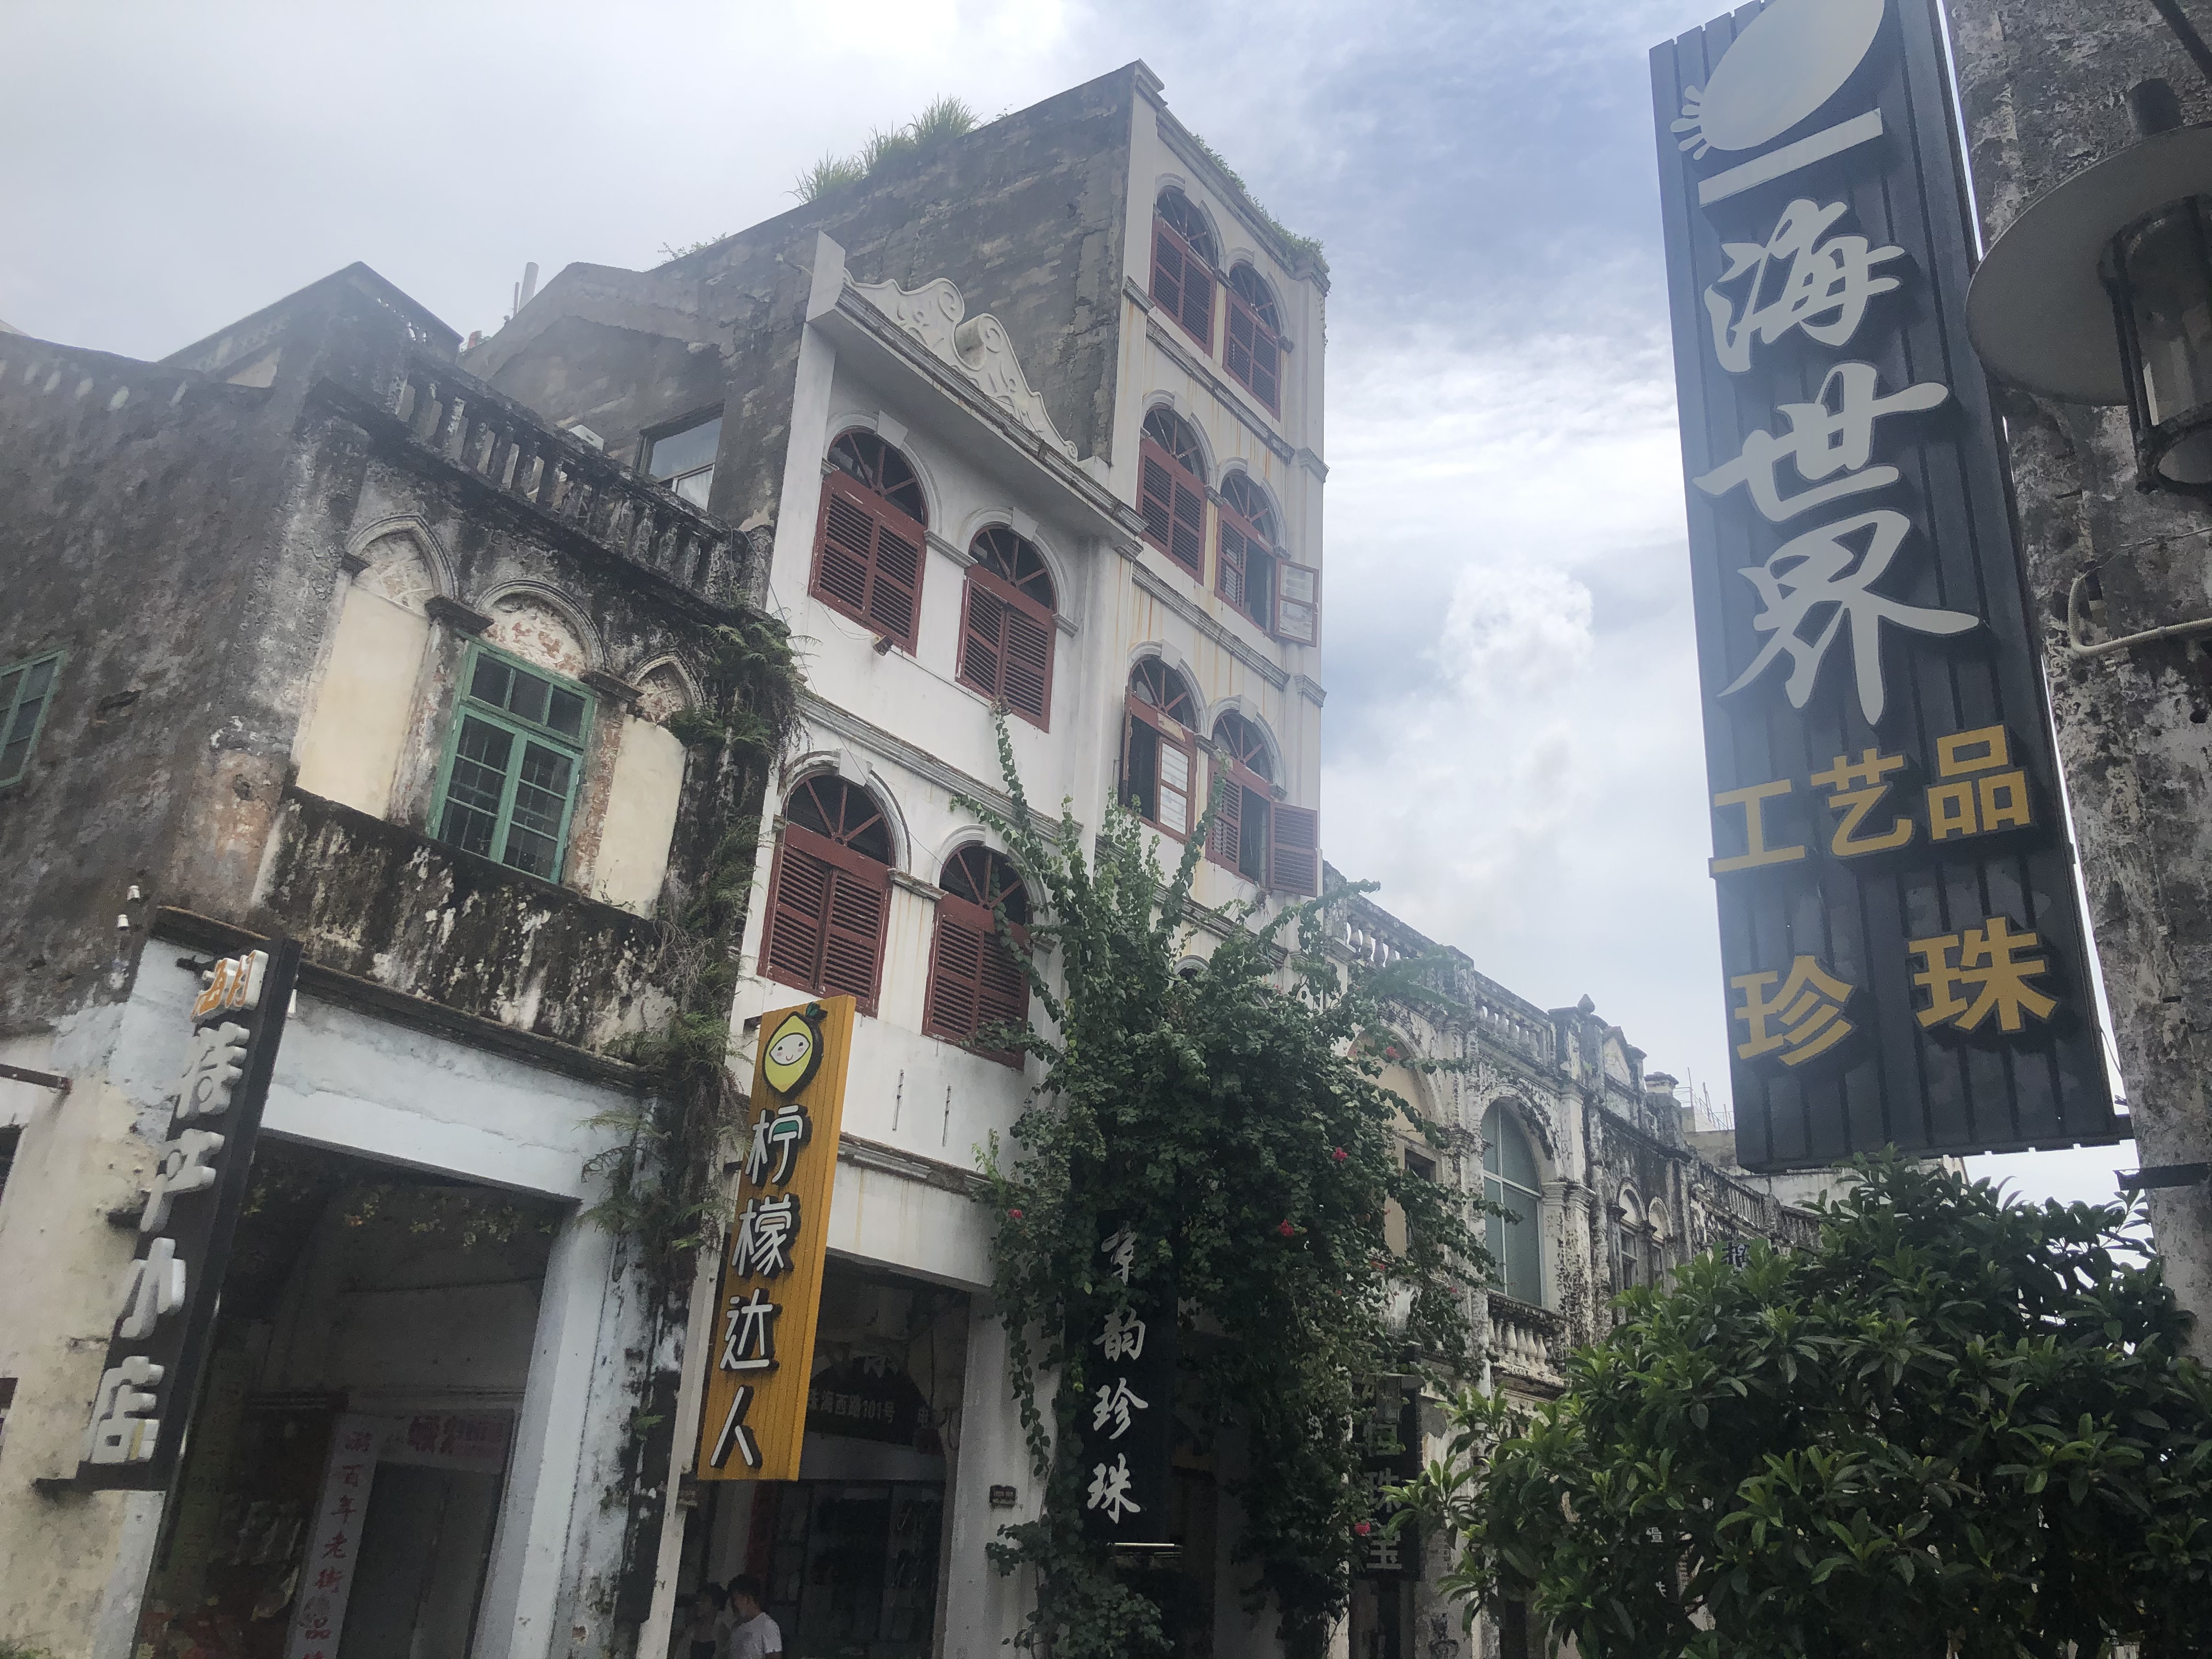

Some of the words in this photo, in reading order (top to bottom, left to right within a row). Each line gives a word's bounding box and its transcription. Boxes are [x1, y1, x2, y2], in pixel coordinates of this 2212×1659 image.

[1709, 725, 2032, 875] 工艺品
[1730, 916, 2058, 1066] 珍珠
[710, 1104, 803, 1469] 柠檬达人
